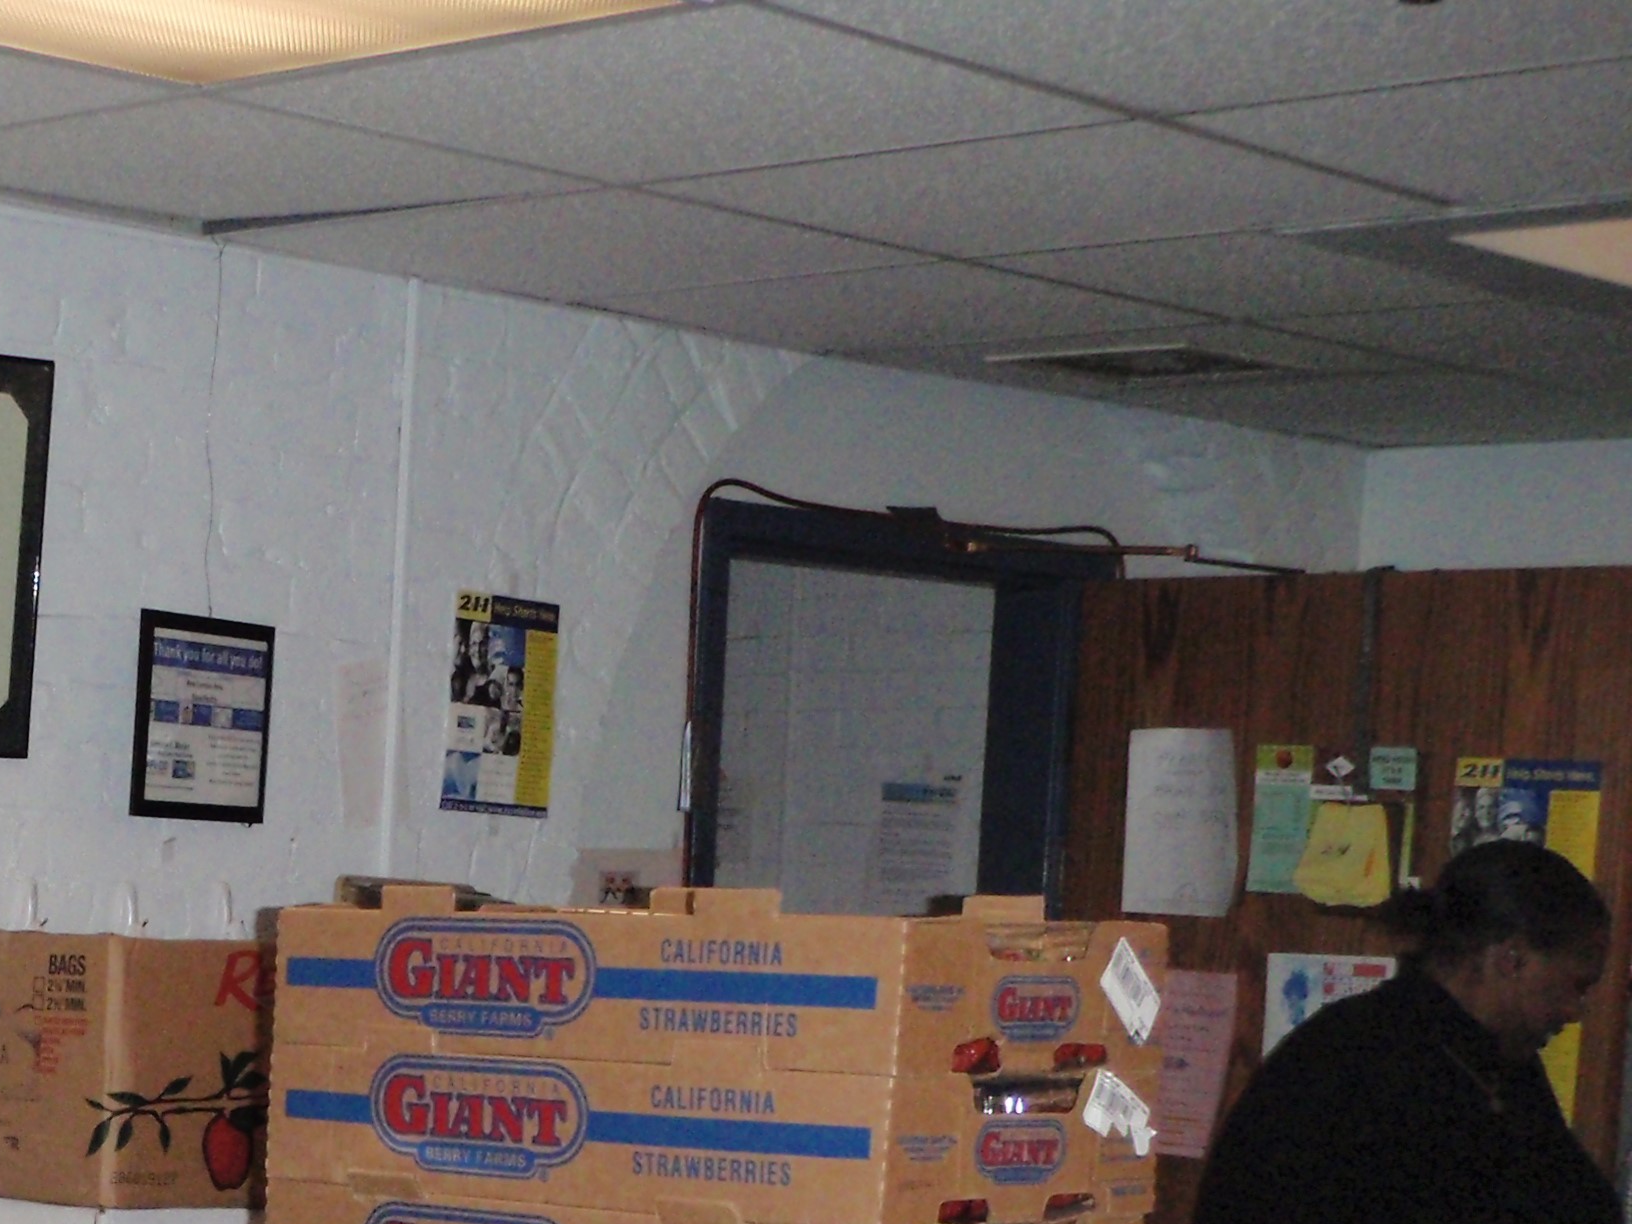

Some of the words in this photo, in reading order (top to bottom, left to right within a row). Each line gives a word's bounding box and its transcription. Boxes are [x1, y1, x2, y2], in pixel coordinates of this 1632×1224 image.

[49, 954, 86, 976] BAGS
[661, 938, 783, 966] CALIFORNIA
[388, 937, 575, 1004] GIANT
[429, 1008, 475, 1025] BERRY
[480, 1009, 533, 1027] FARMS
[997, 987, 1072, 1022] GIANT
[639, 1006, 798, 1037] STRAWBERRIES
[383, 1074, 567, 1147] GIANT
[650, 1084, 776, 1114] CALIFORNIA
[424, 1145, 471, 1164] BERRY
[475, 1148, 527, 1168] FARMS
[980, 1132, 1059, 1167] GIANT
[632, 1150, 792, 1186] STRAWBERRIES
